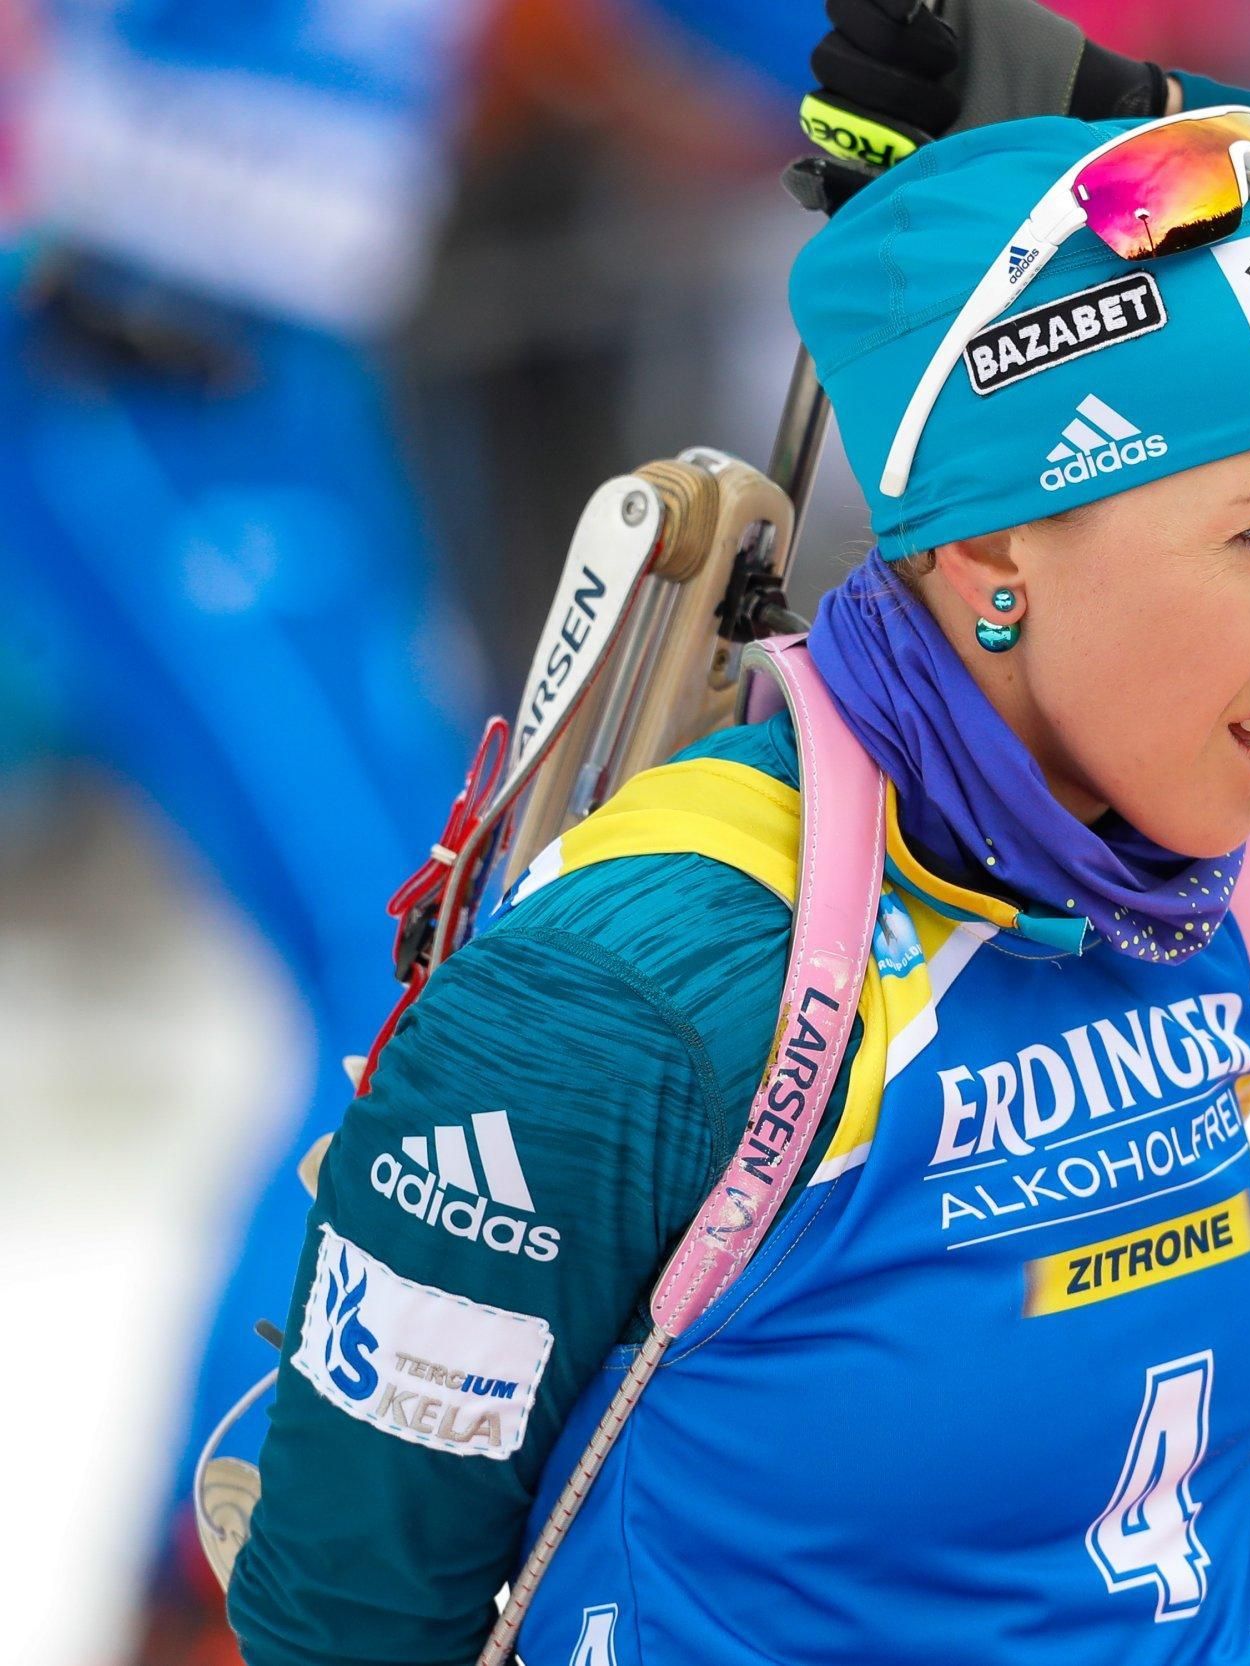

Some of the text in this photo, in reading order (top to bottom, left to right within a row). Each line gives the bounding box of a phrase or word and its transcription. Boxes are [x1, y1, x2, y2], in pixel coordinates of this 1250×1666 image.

[1009, 248, 1040, 284] adidas
[971, 284, 1148, 383] BAZABET
[1039, 434, 1168, 491] adidas
[518, 566, 607, 761] ARSEN
[739, 985, 840, 1186] LARSEN
[370, 1152, 562, 1262] adidas
[941, 1087, 1242, 1230] ALKOHOLFREI
[1066, 1211, 1233, 1295] ZITRONE
[375, 1383, 502, 1447] KELA
[395, 1352, 519, 1399] TERCIUM
[1085, 1349, 1212, 1623] 4
